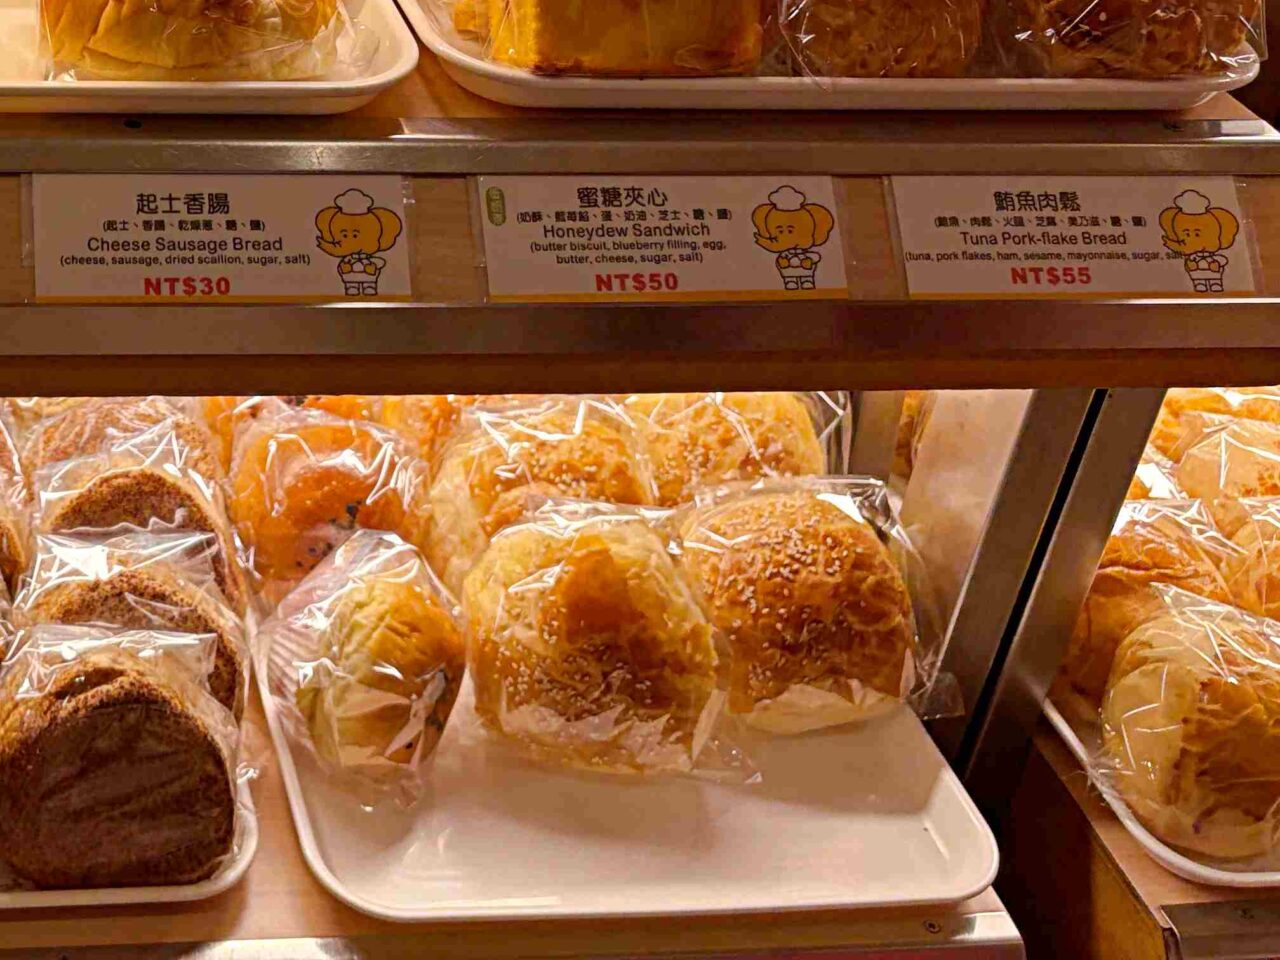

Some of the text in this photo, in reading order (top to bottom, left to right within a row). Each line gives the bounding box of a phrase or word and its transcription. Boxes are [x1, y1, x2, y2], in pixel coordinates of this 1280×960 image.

[136, 193, 230, 215] 起士香腸
[577, 187, 668, 208] 蜜糖夾心
[993, 191, 1081, 211] 鮪魚肉鬆
[543, 223, 710, 240] Honeydew Sandwich
[960, 232, 1127, 246] Tuna Pork-flake Bread
[87, 237, 283, 254] Cheese Sausage Bread
[530, 242, 567, 253] (butter
[613, 241, 664, 253] blueberry
[60, 255, 108, 266] (cheese,
[111, 255, 162, 267] sausage,
[165, 254, 194, 265] dried
[285, 254, 311, 266] salt)
[595, 253, 637, 264] cheese,
[679, 253, 703, 263] salt)
[905, 252, 934, 262] (tuna,
[936, 252, 959, 263] pork
[962, 251, 994, 262] flakes,
[997, 252, 1021, 262] ham,
[1024, 253, 1064, 262] sesame,
[595, 273, 678, 293] NT$50
[1011, 267, 1092, 286] NT$55
[144, 277, 230, 296] NT$30
